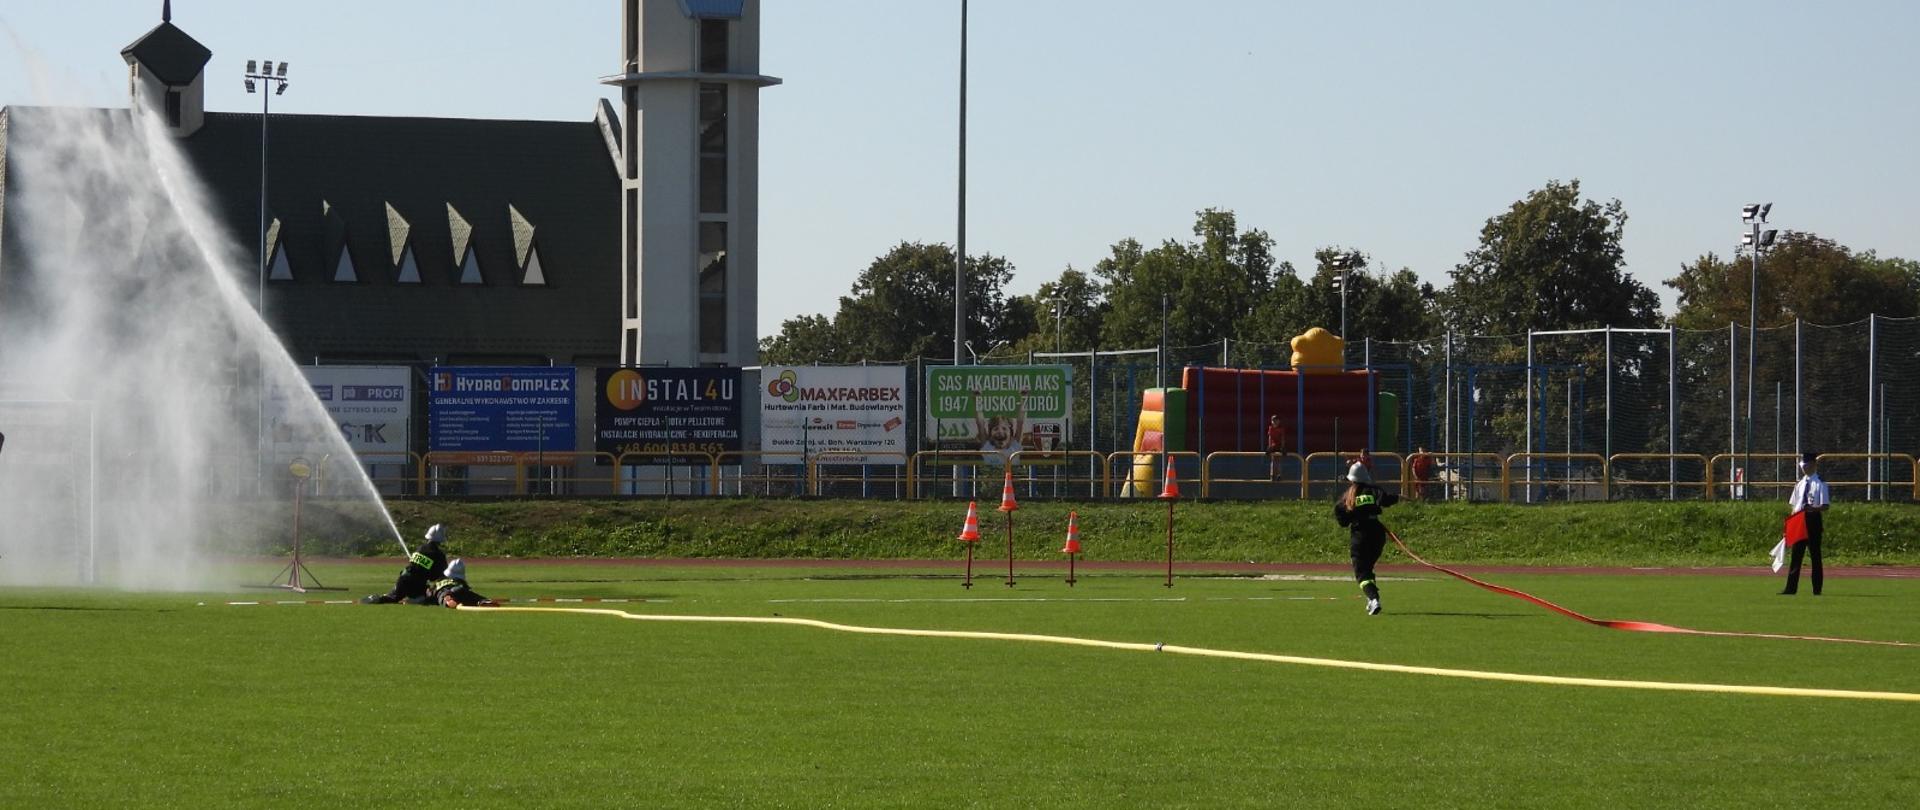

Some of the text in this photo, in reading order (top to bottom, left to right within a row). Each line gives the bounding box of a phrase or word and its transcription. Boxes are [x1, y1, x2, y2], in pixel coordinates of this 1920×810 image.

[938, 375, 1060, 391] SAS AKADEMIA AKS
[367, 388, 403, 399] PROFI
[619, 379, 734, 401] INSTAL4U
[800, 387, 900, 401] MAXFARBEX
[849, 404, 904, 413] Budowlanych
[939, 396, 969, 412] 1947
[614, 417, 636, 426] POMPY
[666, 417, 687, 426] OTŁY
[847, 439, 882, 447] Warszawy
